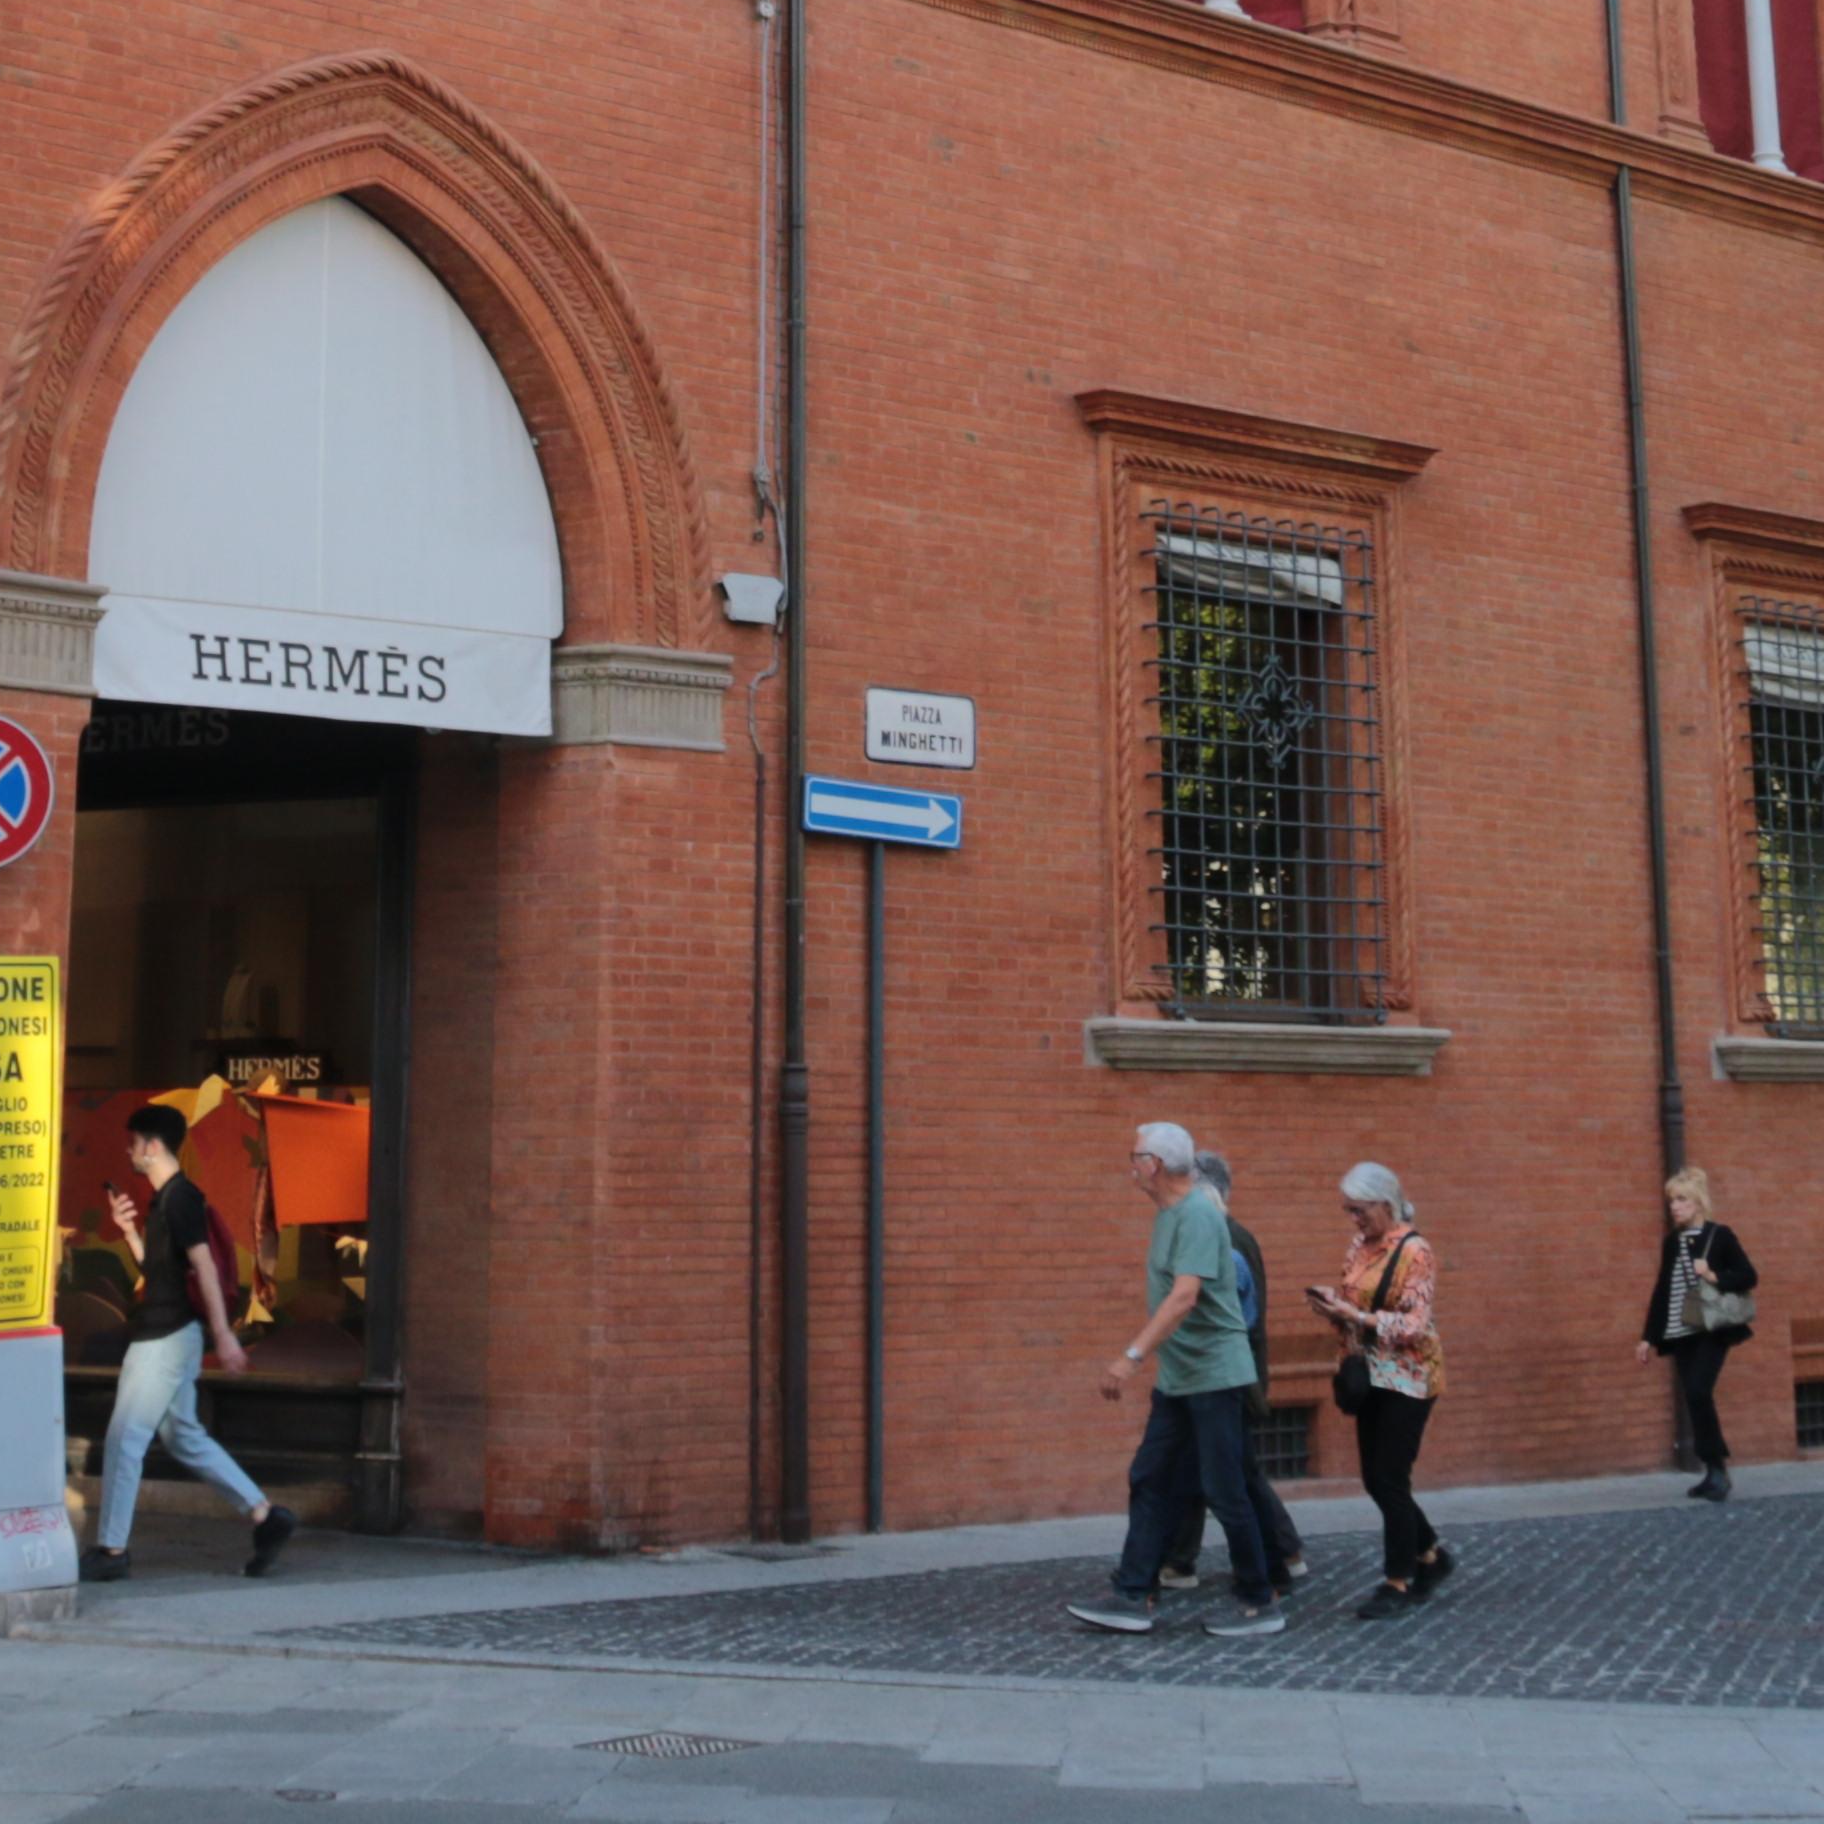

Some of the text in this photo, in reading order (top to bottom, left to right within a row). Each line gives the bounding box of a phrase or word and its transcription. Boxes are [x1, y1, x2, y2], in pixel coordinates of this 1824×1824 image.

[189, 634, 447, 703] HERMÈS
[902, 705, 943, 725] PIAZZA
[881, 730, 962, 754] MINGHETTI
